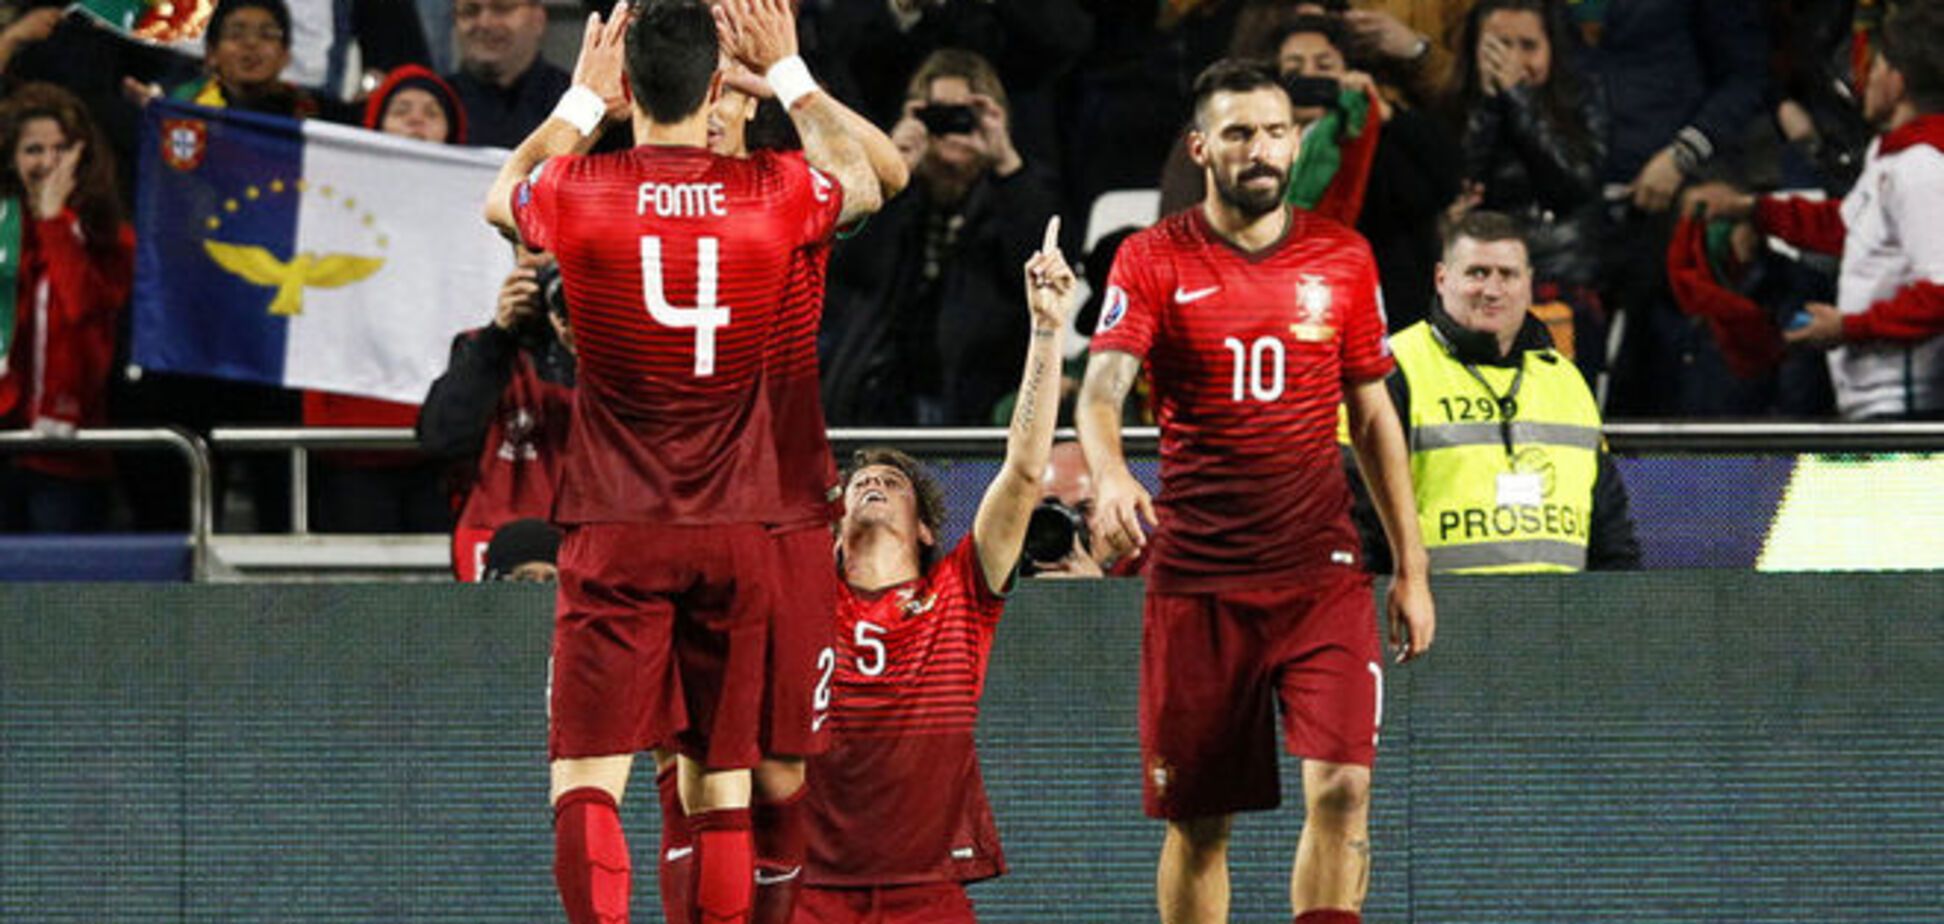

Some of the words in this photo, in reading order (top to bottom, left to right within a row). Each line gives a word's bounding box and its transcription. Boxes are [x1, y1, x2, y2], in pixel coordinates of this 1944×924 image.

[637, 182, 728, 217] FONTE
[640, 236, 731, 377] 4
[1224, 336, 1285, 402] 10
[813, 647, 835, 710] 2
[854, 620, 886, 676] 5
